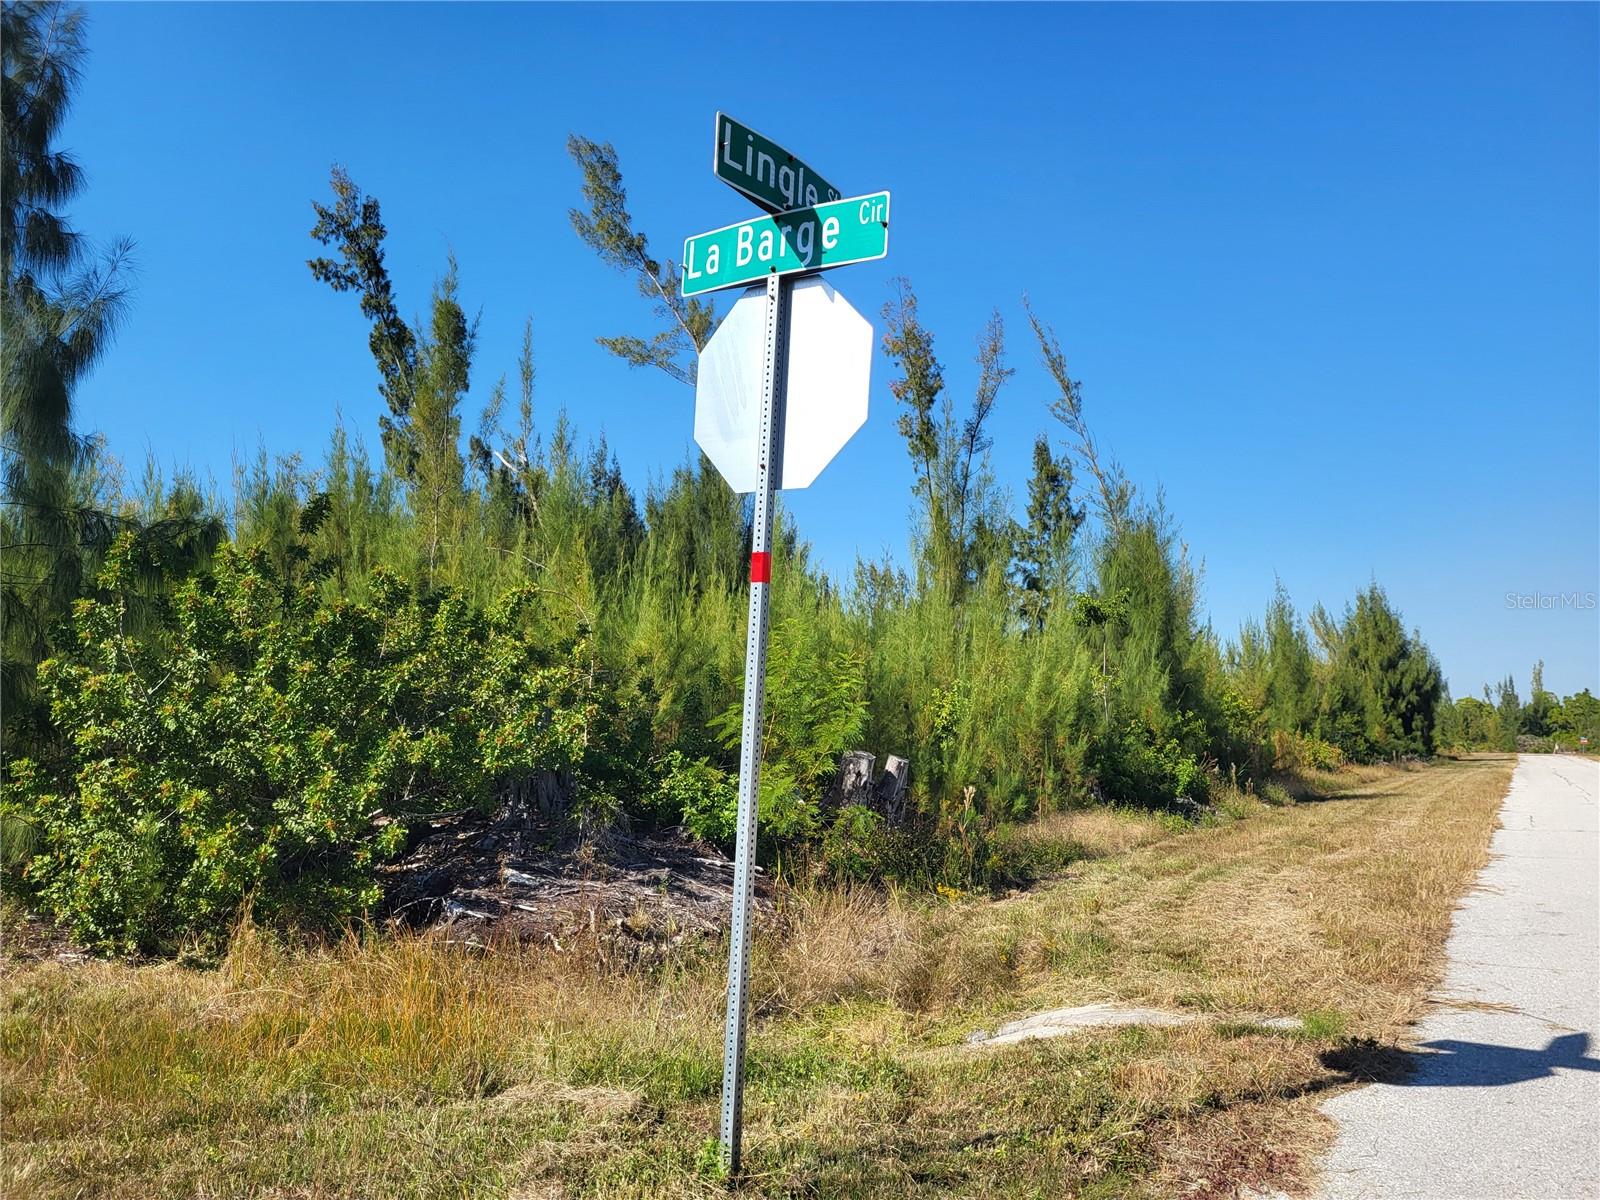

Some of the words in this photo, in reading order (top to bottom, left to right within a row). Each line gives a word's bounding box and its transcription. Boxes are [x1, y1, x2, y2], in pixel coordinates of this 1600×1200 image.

[722, 122, 818, 208] Lingle
[687, 241, 720, 280] La
[736, 216, 840, 268] Barge
[859, 201, 884, 225] Cir
